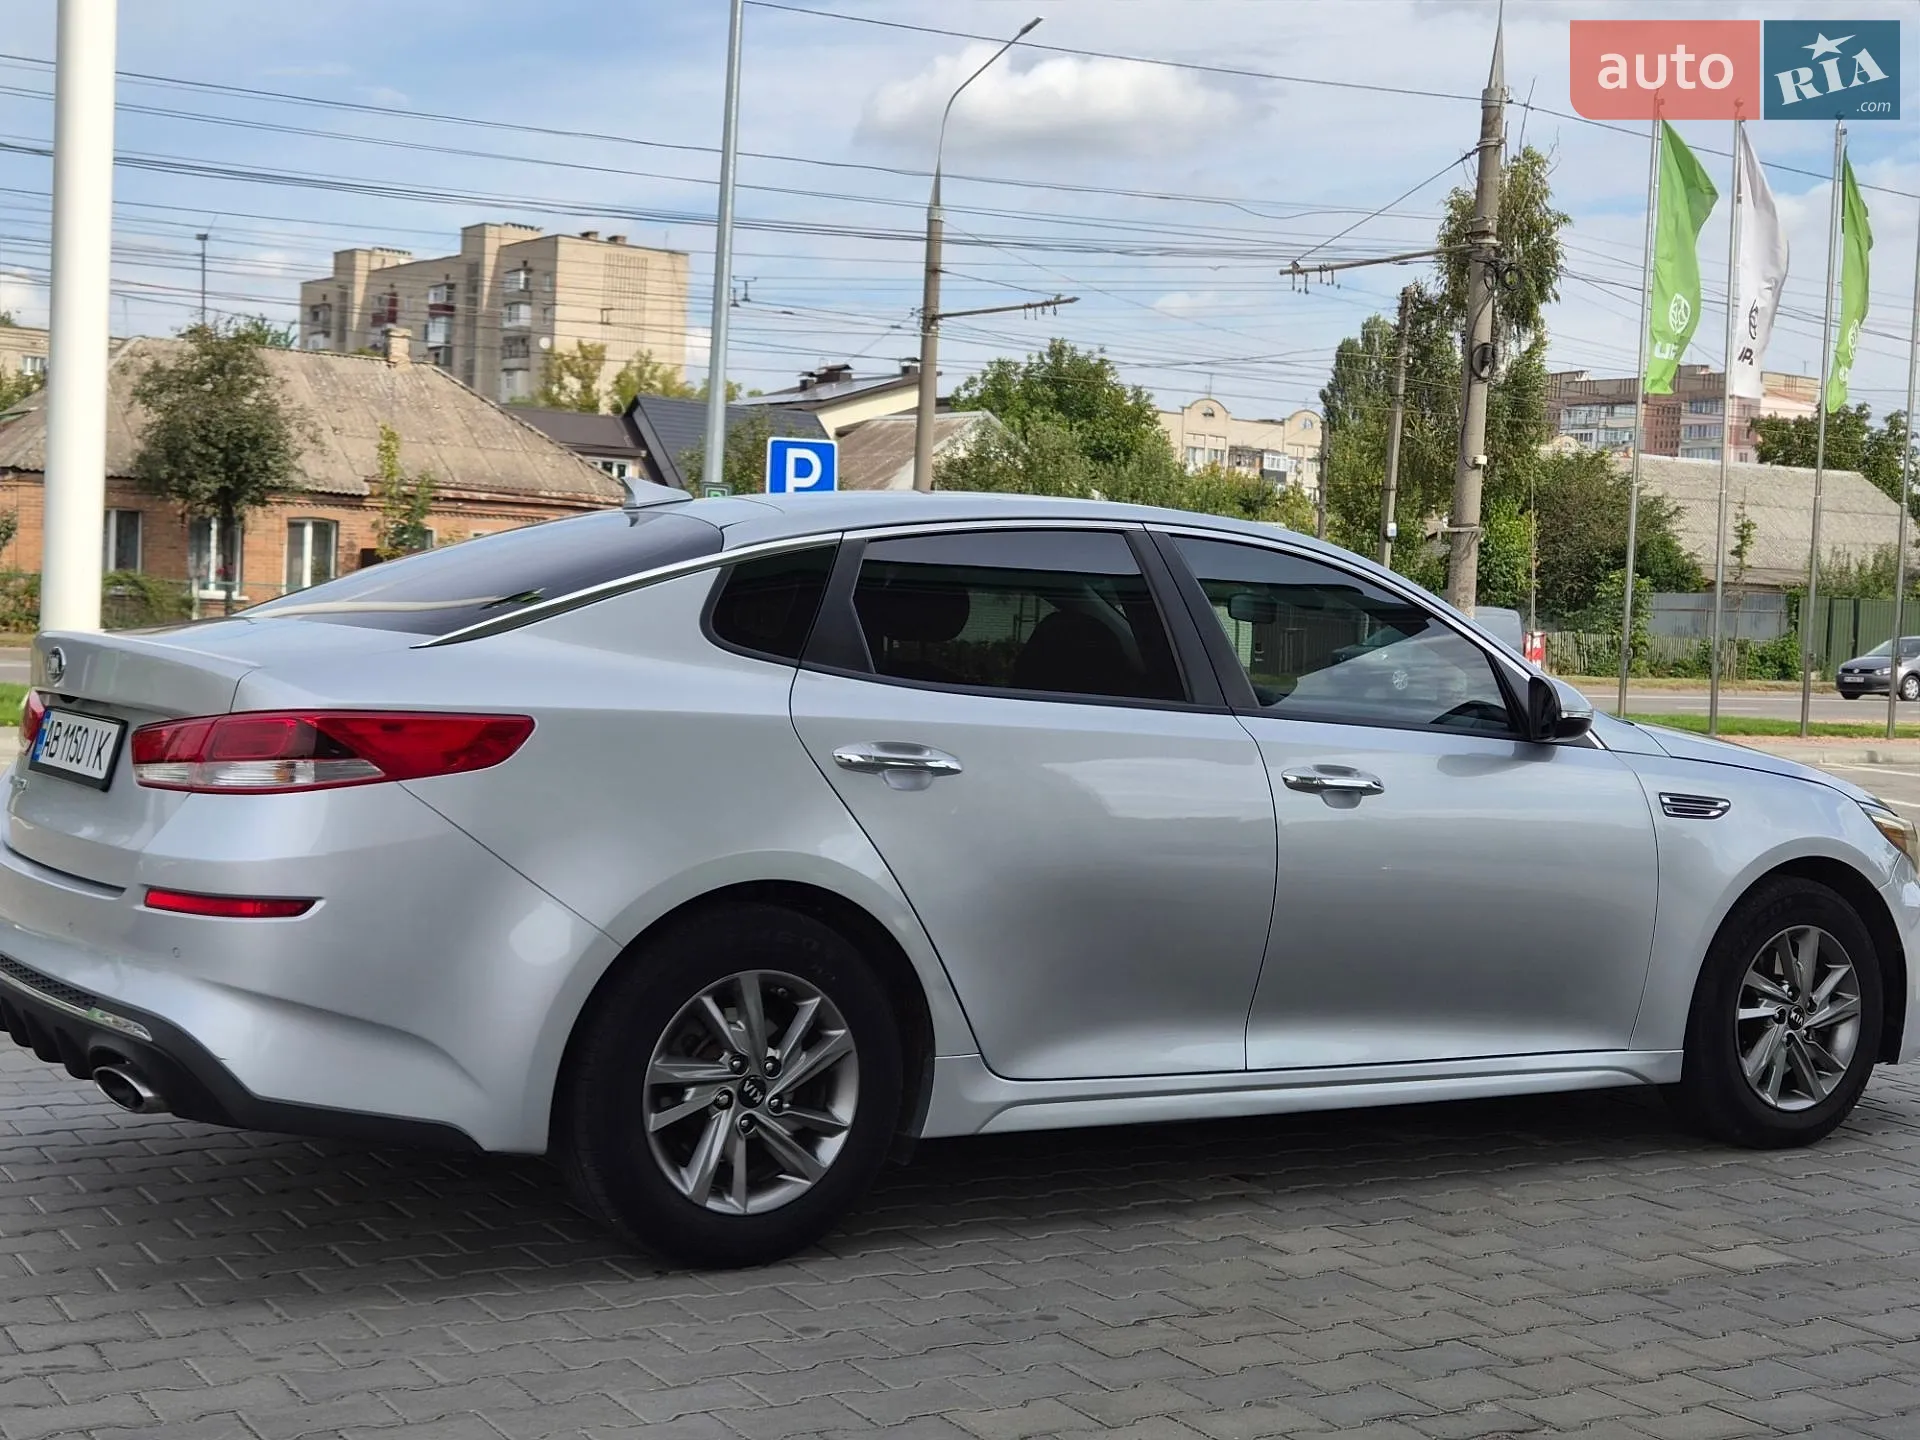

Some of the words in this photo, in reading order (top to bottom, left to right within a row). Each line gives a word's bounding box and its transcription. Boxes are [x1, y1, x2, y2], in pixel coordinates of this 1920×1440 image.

[785, 447, 823, 492] P
[41, 719, 62, 758] AB
[60, 723, 89, 764] 1150
[86, 729, 112, 771] IK
[1789, 1010, 1804, 1026] KIA
[743, 1080, 764, 1104] KIA
